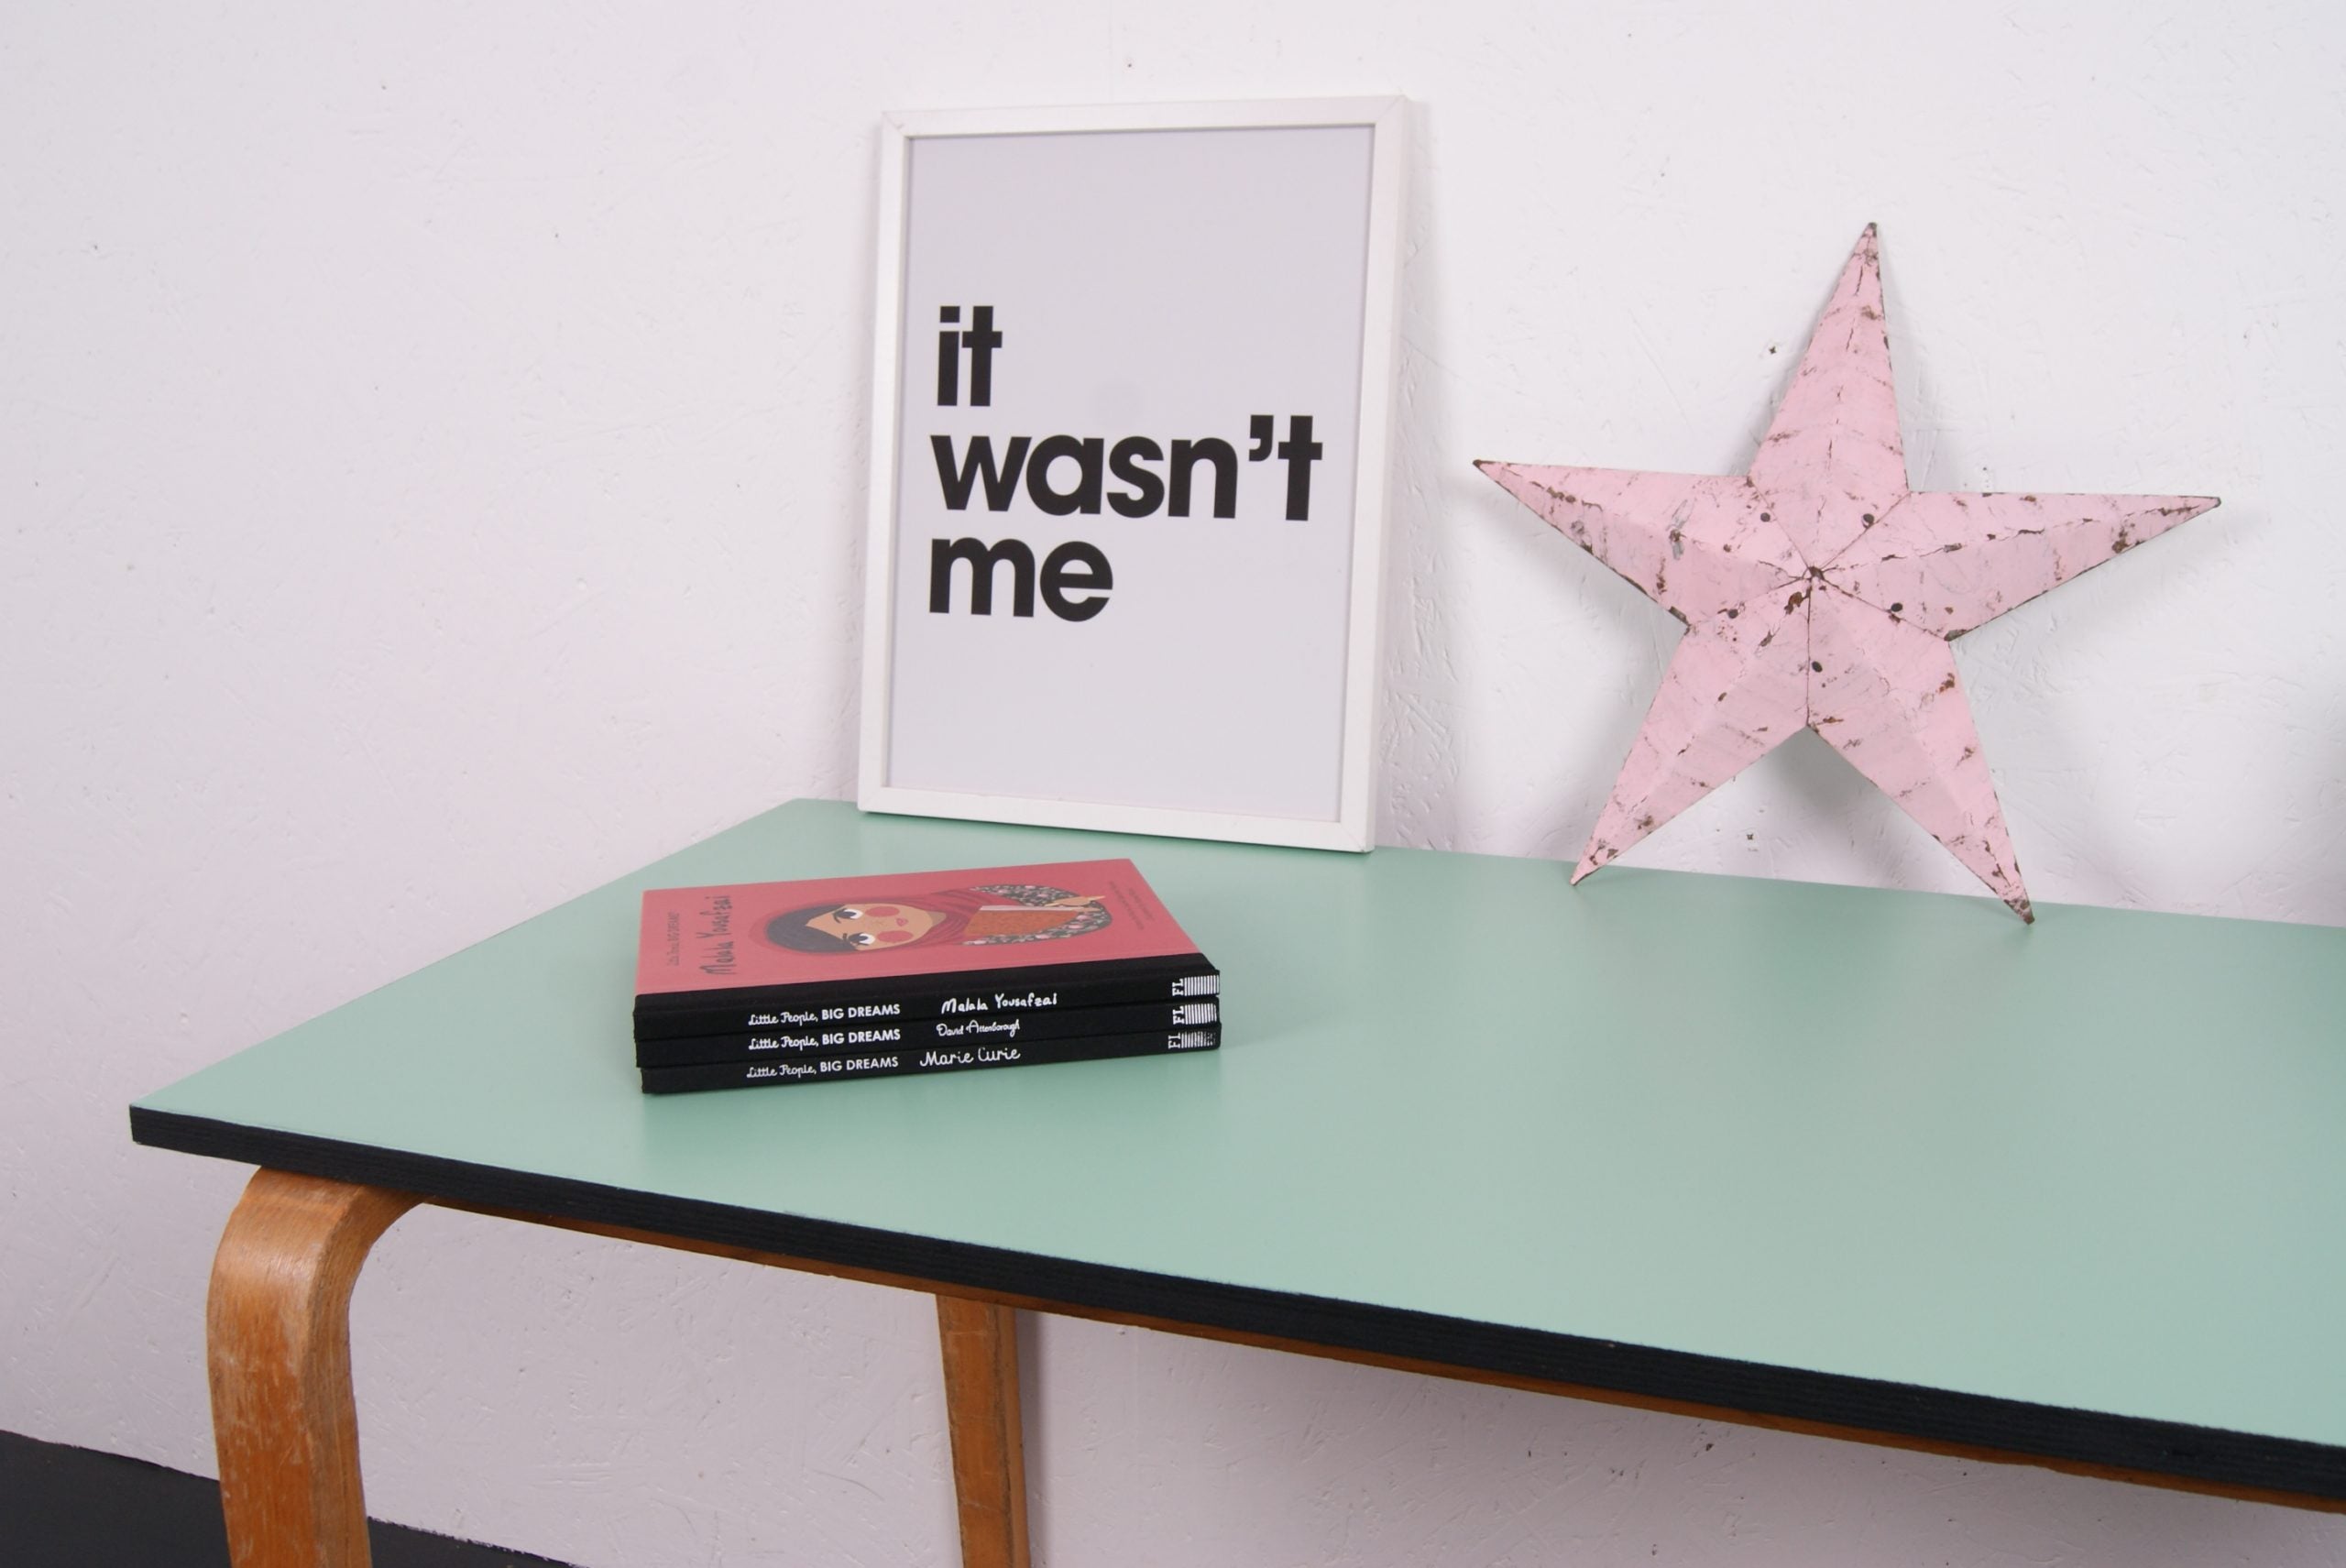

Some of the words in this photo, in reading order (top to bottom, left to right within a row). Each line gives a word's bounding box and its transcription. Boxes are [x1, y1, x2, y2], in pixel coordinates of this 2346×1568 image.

[936, 305, 1003, 407] it
[930, 414, 1323, 521] wasn't
[929, 537, 1114, 622] me
[748, 1014, 779, 1026] Little
[780, 1011, 818, 1026] People,
[821, 1008, 844, 1020] BIG
[848, 1003, 901, 1018] DREAMS
[941, 998, 989, 1014] Malala
[994, 992, 1058, 1009] Yousafzai
[748, 1037, 779, 1050] Little
[780, 1036, 819, 1051] People,
[822, 1033, 845, 1045] BIG
[849, 1028, 901, 1044] DREAMS
[936, 1023, 964, 1036] David
[746, 1067, 778, 1079] Little
[779, 1064, 817, 1079] People,
[819, 1060, 842, 1072] BIG
[846, 1056, 899, 1070] DREAMS
[919, 1050, 974, 1067] Marie
[978, 1047, 1021, 1062] Curie
